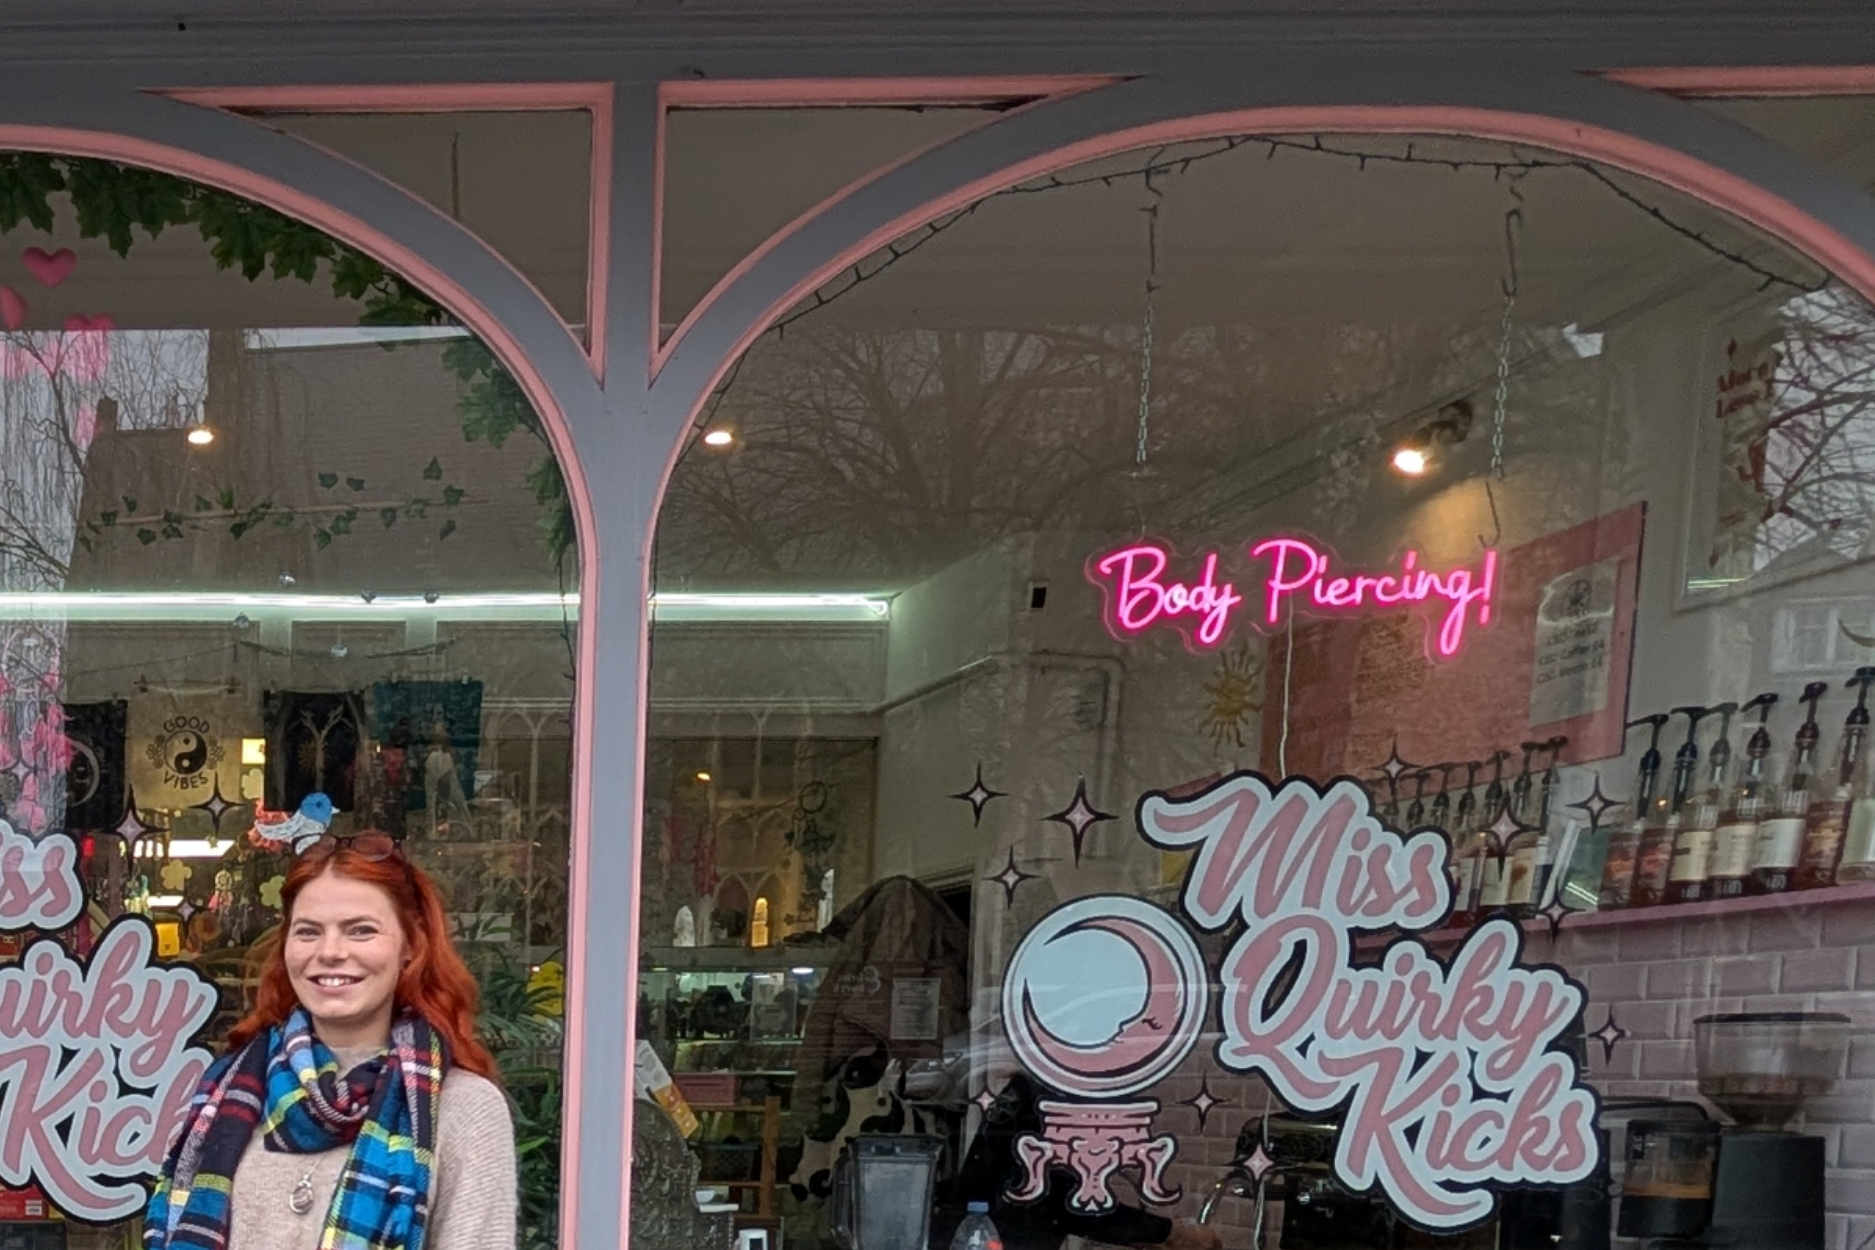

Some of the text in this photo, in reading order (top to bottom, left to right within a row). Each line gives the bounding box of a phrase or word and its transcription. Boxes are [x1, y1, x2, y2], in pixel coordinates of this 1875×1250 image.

[1100, 538, 1497, 656] Body Piercing!
[163, 715, 210, 734] GOOD
[163, 770, 209, 791] VIBES
[1153, 789, 1438, 919] Miss
[1231, 914, 1569, 1100] Quirky
[1317, 1046, 1588, 1217] Kicks
